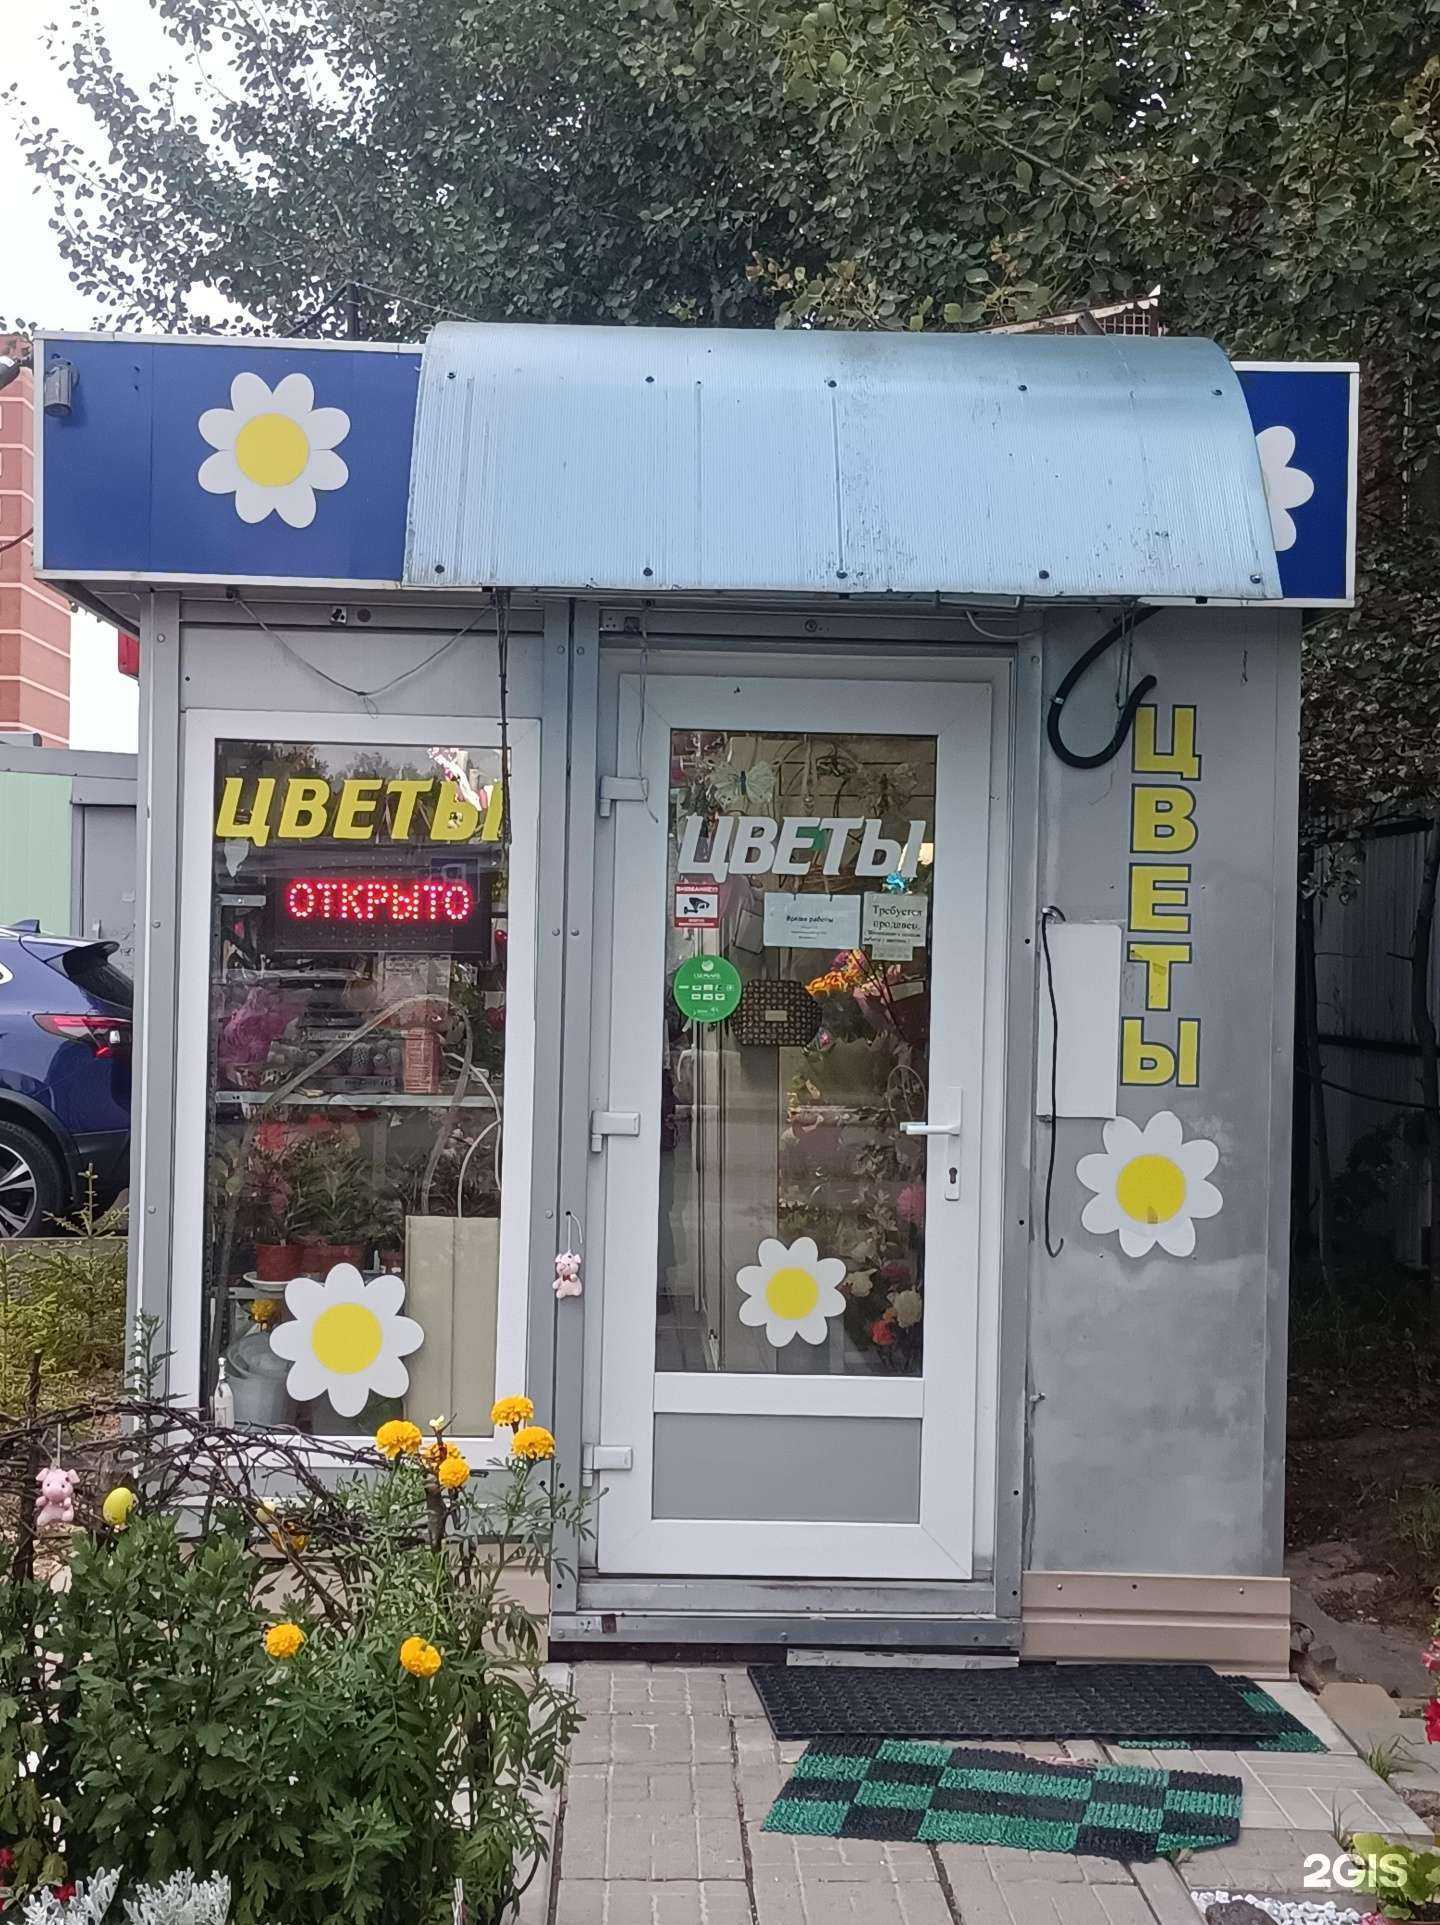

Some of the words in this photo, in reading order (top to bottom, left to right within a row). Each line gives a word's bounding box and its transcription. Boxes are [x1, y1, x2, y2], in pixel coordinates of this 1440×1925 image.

[215, 777, 503, 847] ЦВЕТЫ
[677, 815, 927, 883] ЦВЕТЫ
[288, 882, 470, 921] ОТКРЫТО
[872, 904, 922, 918] Требуется
[1120, 704, 1202, 1087] ЦВЕТЫ
